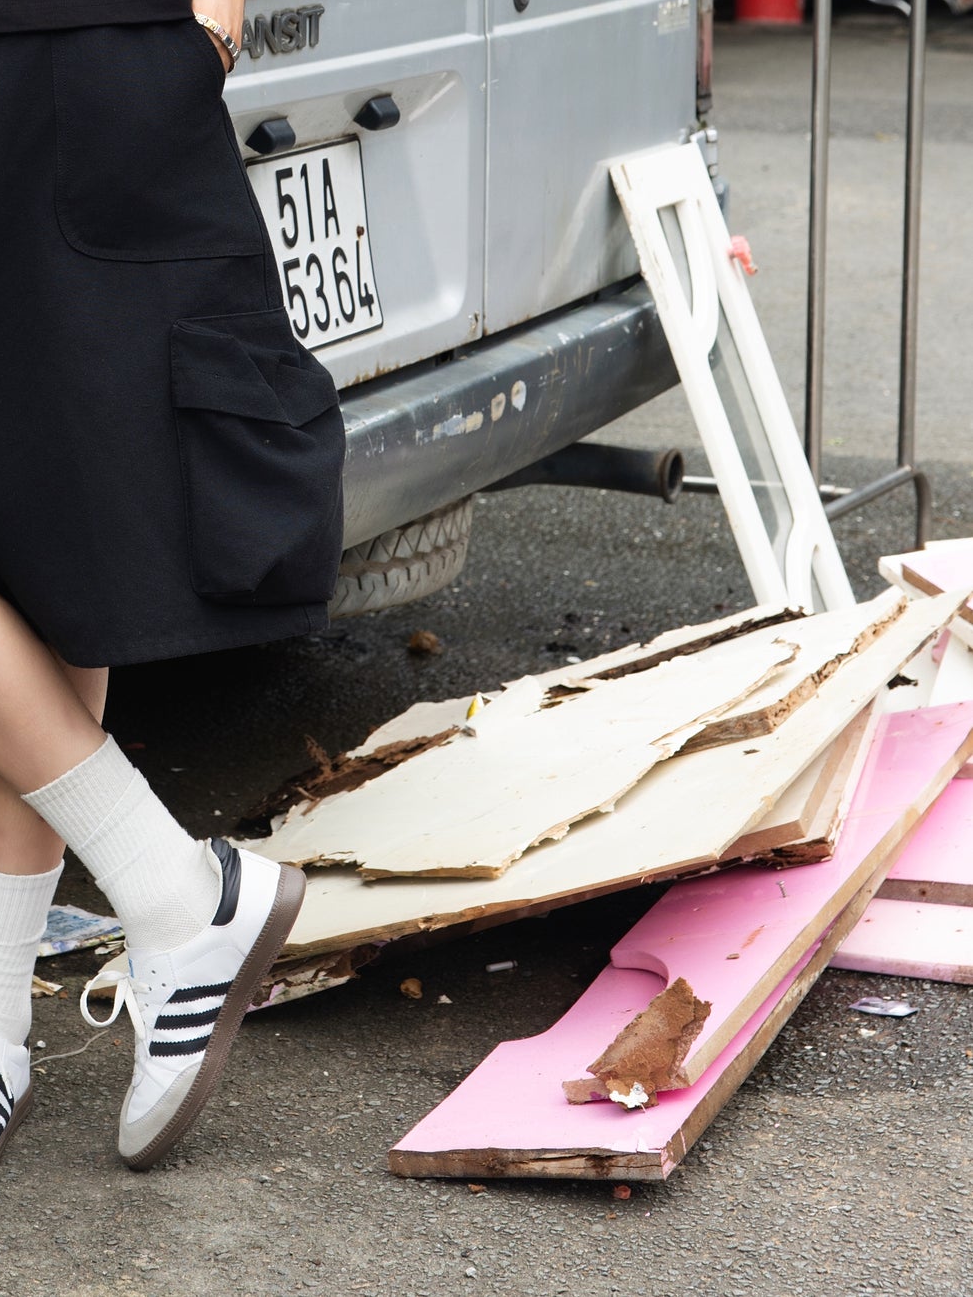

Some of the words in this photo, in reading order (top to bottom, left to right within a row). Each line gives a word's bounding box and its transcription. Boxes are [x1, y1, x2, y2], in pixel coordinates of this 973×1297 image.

[241, 4, 325, 59] ANSIT
[276, 158, 340, 248] 51A
[283, 240, 374, 339] 53.64
